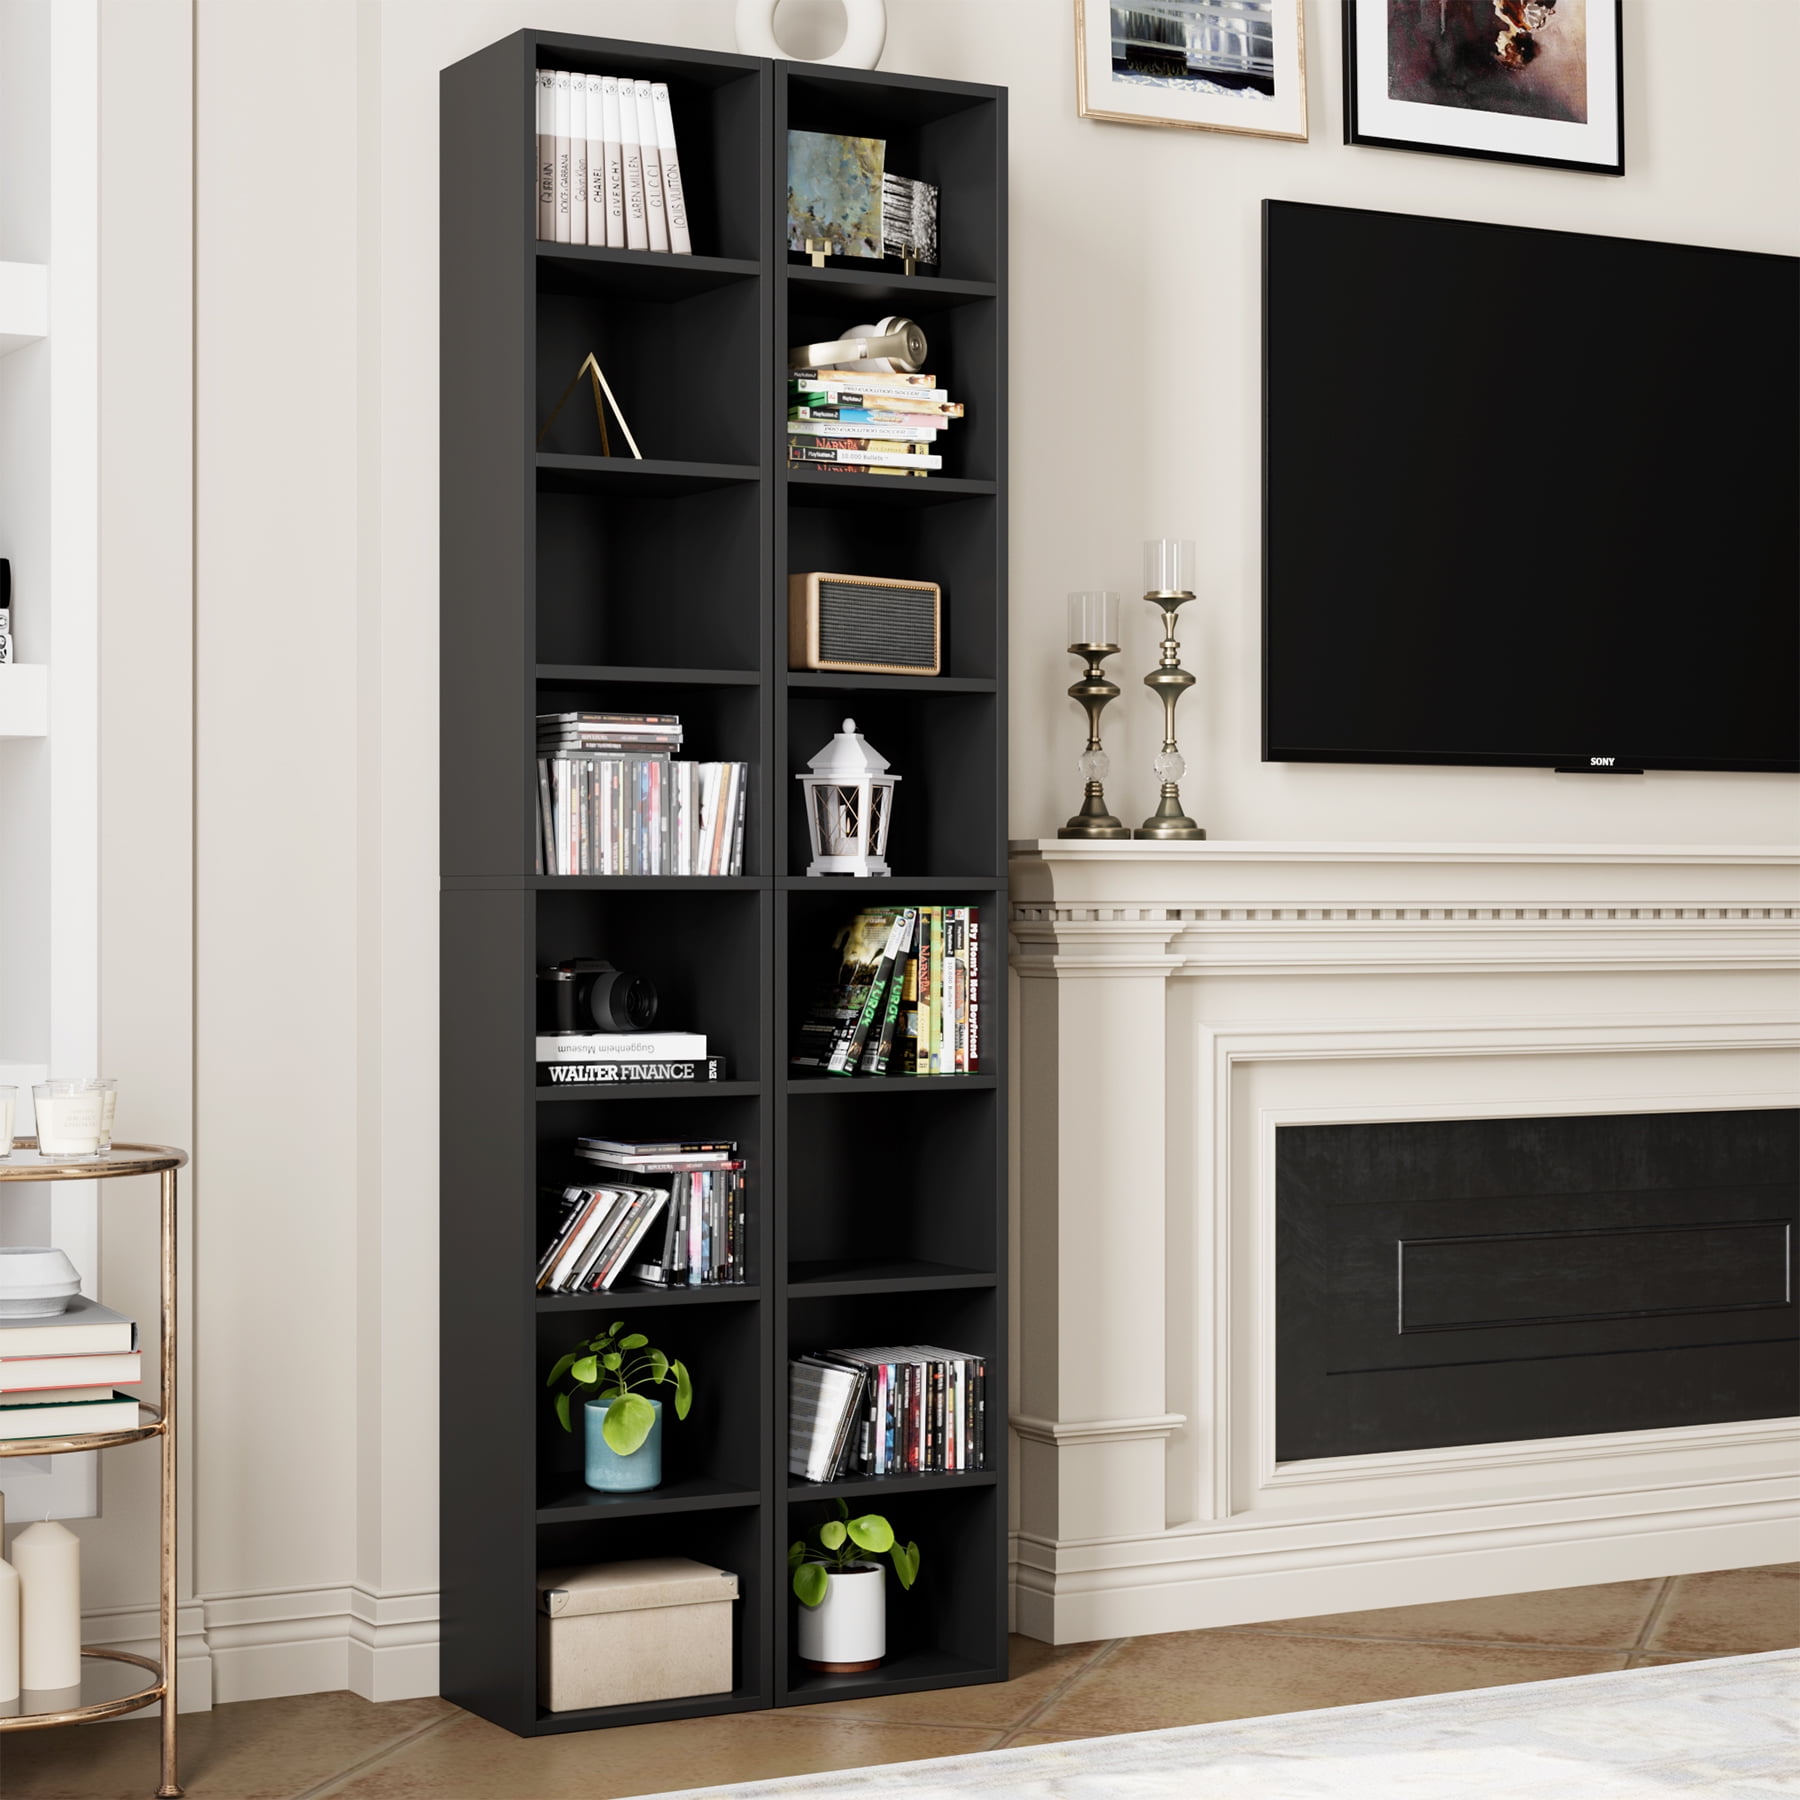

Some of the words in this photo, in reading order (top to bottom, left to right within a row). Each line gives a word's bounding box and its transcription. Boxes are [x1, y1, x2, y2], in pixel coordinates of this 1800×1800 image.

[593, 167, 602, 204] CHANEL
[628, 156, 642, 189] MILLEN
[647, 164, 662, 208] GUCCI
[666, 163, 682, 202] VUITTON
[611, 160, 621, 217] GIVENCHY
[631, 190, 643, 219] KAREN
[672, 203, 686, 229] LOUIS
[1590, 757, 1615, 766] SONY
[969, 923, 978, 940] My
[969, 942, 978, 977] Mom's
[969, 979, 978, 1001] New
[969, 1004, 978, 1058] Boyfriend
[557, 1045, 596, 1054] Museum
[598, 1044, 655, 1054] Guggenheim
[548, 1064, 619, 1082] WALTER
[619, 1063, 694, 1080] FINANCE
